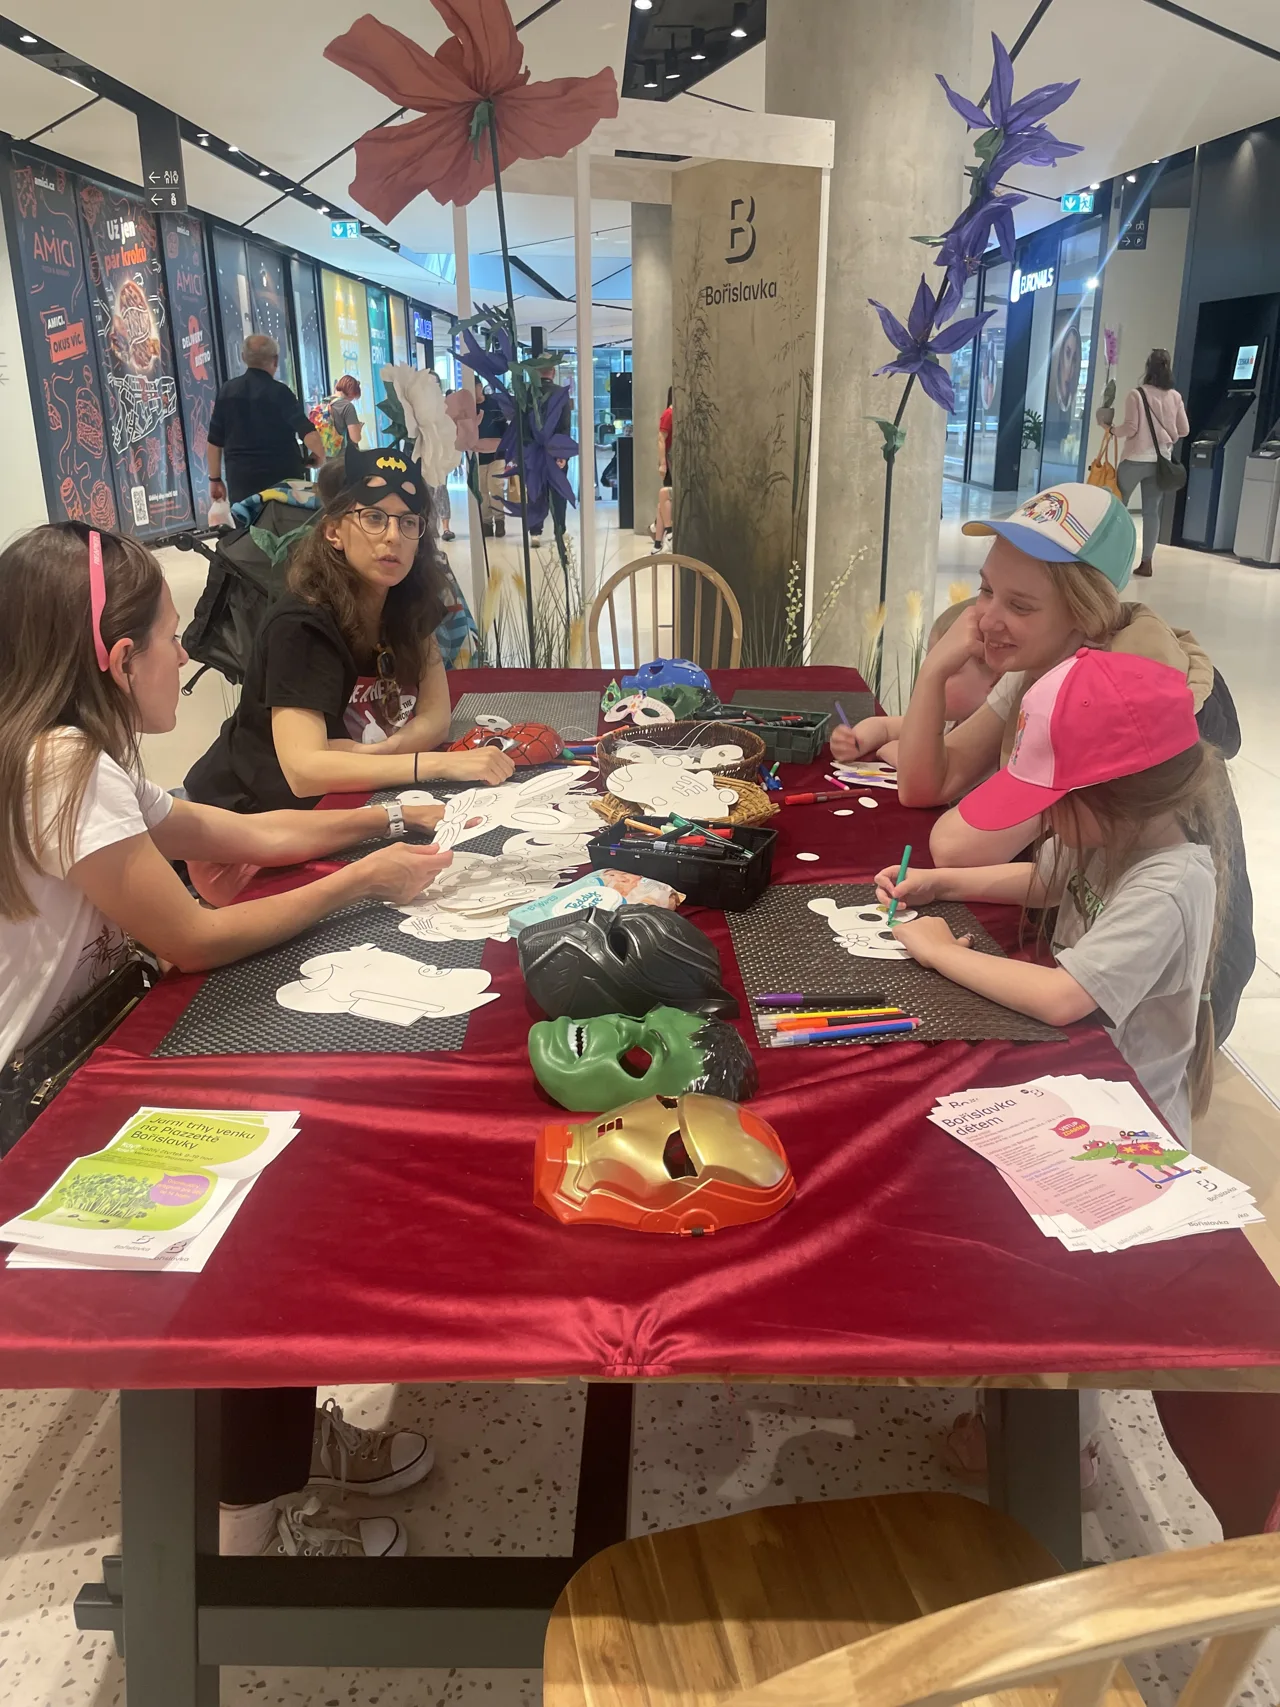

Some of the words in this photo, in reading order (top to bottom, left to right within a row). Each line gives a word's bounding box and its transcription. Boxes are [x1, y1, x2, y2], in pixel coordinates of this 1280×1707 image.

[106, 219, 120, 240] Už
[119, 216, 136, 244] jen
[33, 226, 75, 268] AMICI
[104, 249, 120, 277] pár
[120, 241, 147, 267] kroků
[1020, 267, 1054, 295] EURONAILS
[705, 278, 777, 306] Bořislavka
[53, 337, 71, 353] OKUS
[564, 890, 601, 909] Teddy
[942, 1097, 1017, 1128] Bořislavka
[140, 1124, 157, 1132] na
[161, 1126, 221, 1144] Piazzettě
[149, 1117, 184, 1127] Jarní
[186, 1121, 214, 1133] trhy
[216, 1127, 256, 1140] venku
[956, 1115, 1004, 1136] dětem
[130, 1131, 199, 1151] Bořislavky
[1206, 1186, 1238, 1203] Bořislavka
[1187, 1219, 1230, 1228] Bořislavka
[113, 1244, 152, 1252] Bořislavka
